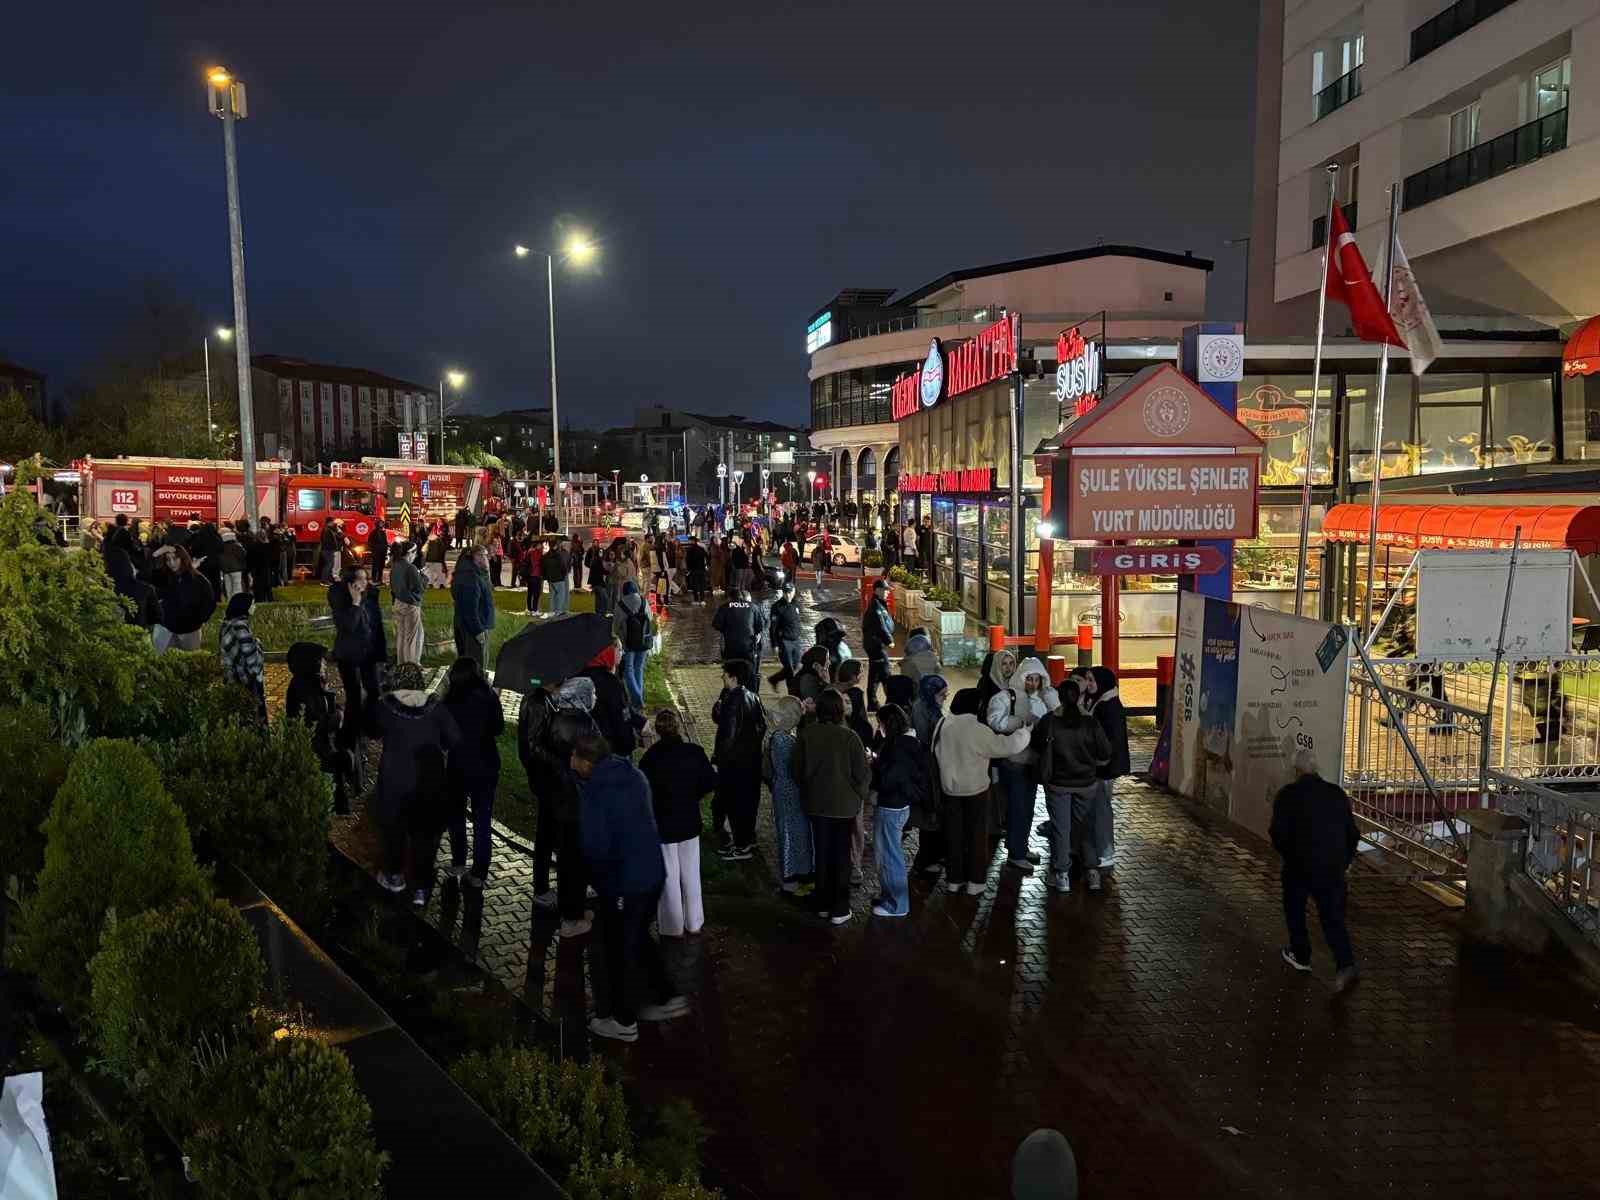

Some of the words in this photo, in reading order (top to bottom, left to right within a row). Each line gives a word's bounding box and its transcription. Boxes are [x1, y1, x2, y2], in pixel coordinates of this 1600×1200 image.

[1080, 467, 1120, 497] ŞULE
[1125, 464, 1185, 491] YÜKSEL
[1190, 467, 1249, 496] ŞENLER
[114, 491, 135, 503] 112
[1092, 510, 1134, 532] YURT
[1138, 504, 1236, 532] MÜDÜRLÜĞÜ
[1296, 732, 1313, 749] GSB
